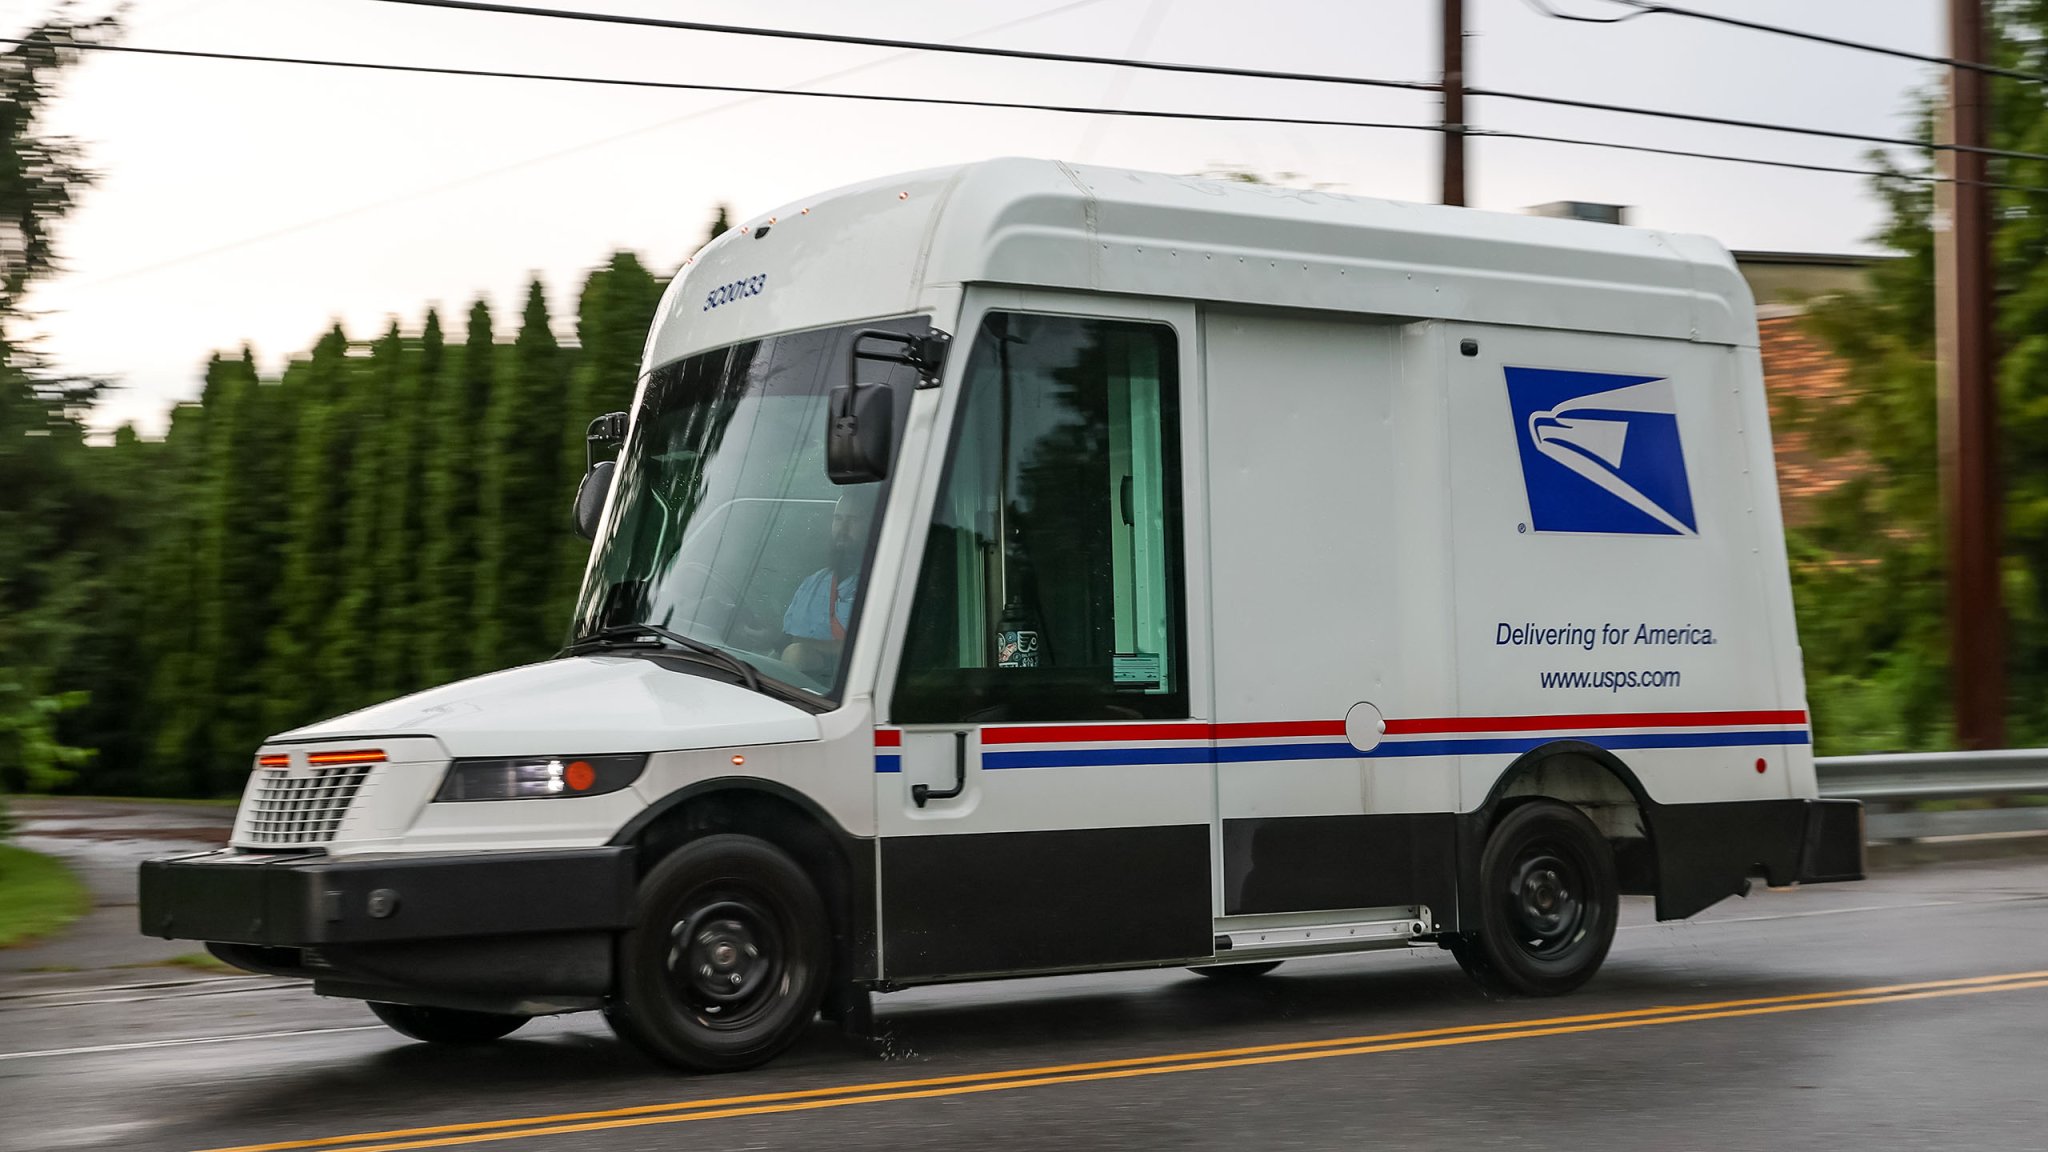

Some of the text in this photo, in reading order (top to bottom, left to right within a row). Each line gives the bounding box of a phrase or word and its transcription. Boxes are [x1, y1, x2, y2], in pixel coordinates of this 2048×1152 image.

[1495, 622, 1597, 651] Delivering
[1602, 622, 1631, 646] for
[1540, 670, 1681, 694] www.usps.com
